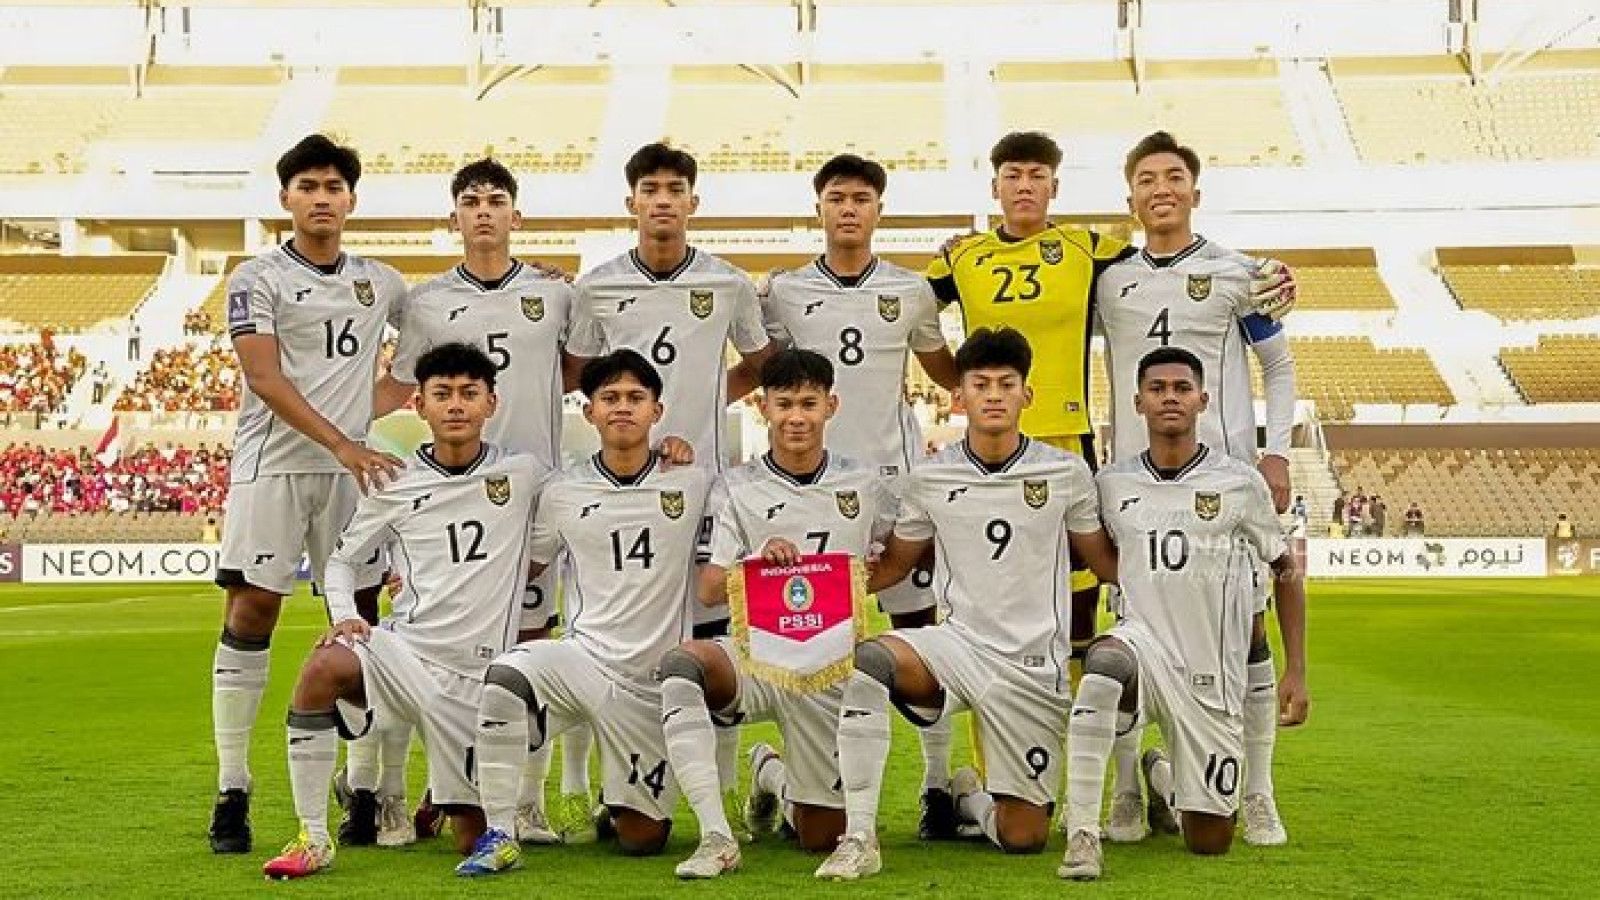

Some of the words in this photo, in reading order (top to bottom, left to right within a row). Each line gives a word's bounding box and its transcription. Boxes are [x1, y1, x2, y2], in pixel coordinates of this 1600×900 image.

[992, 264, 1041, 303] 23
[324, 318, 359, 358] 16
[1147, 308, 1172, 345] 4
[487, 333, 511, 371] 5
[651, 326, 676, 366] 6
[839, 327, 865, 365] 8
[446, 521, 487, 562] 12
[610, 528, 654, 571] 14
[806, 531, 831, 555] 7
[986, 519, 1013, 561] 9
[1147, 529, 1189, 571] 10
[1328, 551, 1405, 566] NEOM
[1458, 544, 1523, 569] نيوم
[42, 550, 220, 577] NEOM.CO
[778, 613, 824, 631] PSSI
[628, 753, 668, 799] 14
[1026, 746, 1048, 781] 9
[1206, 752, 1238, 796] 10
